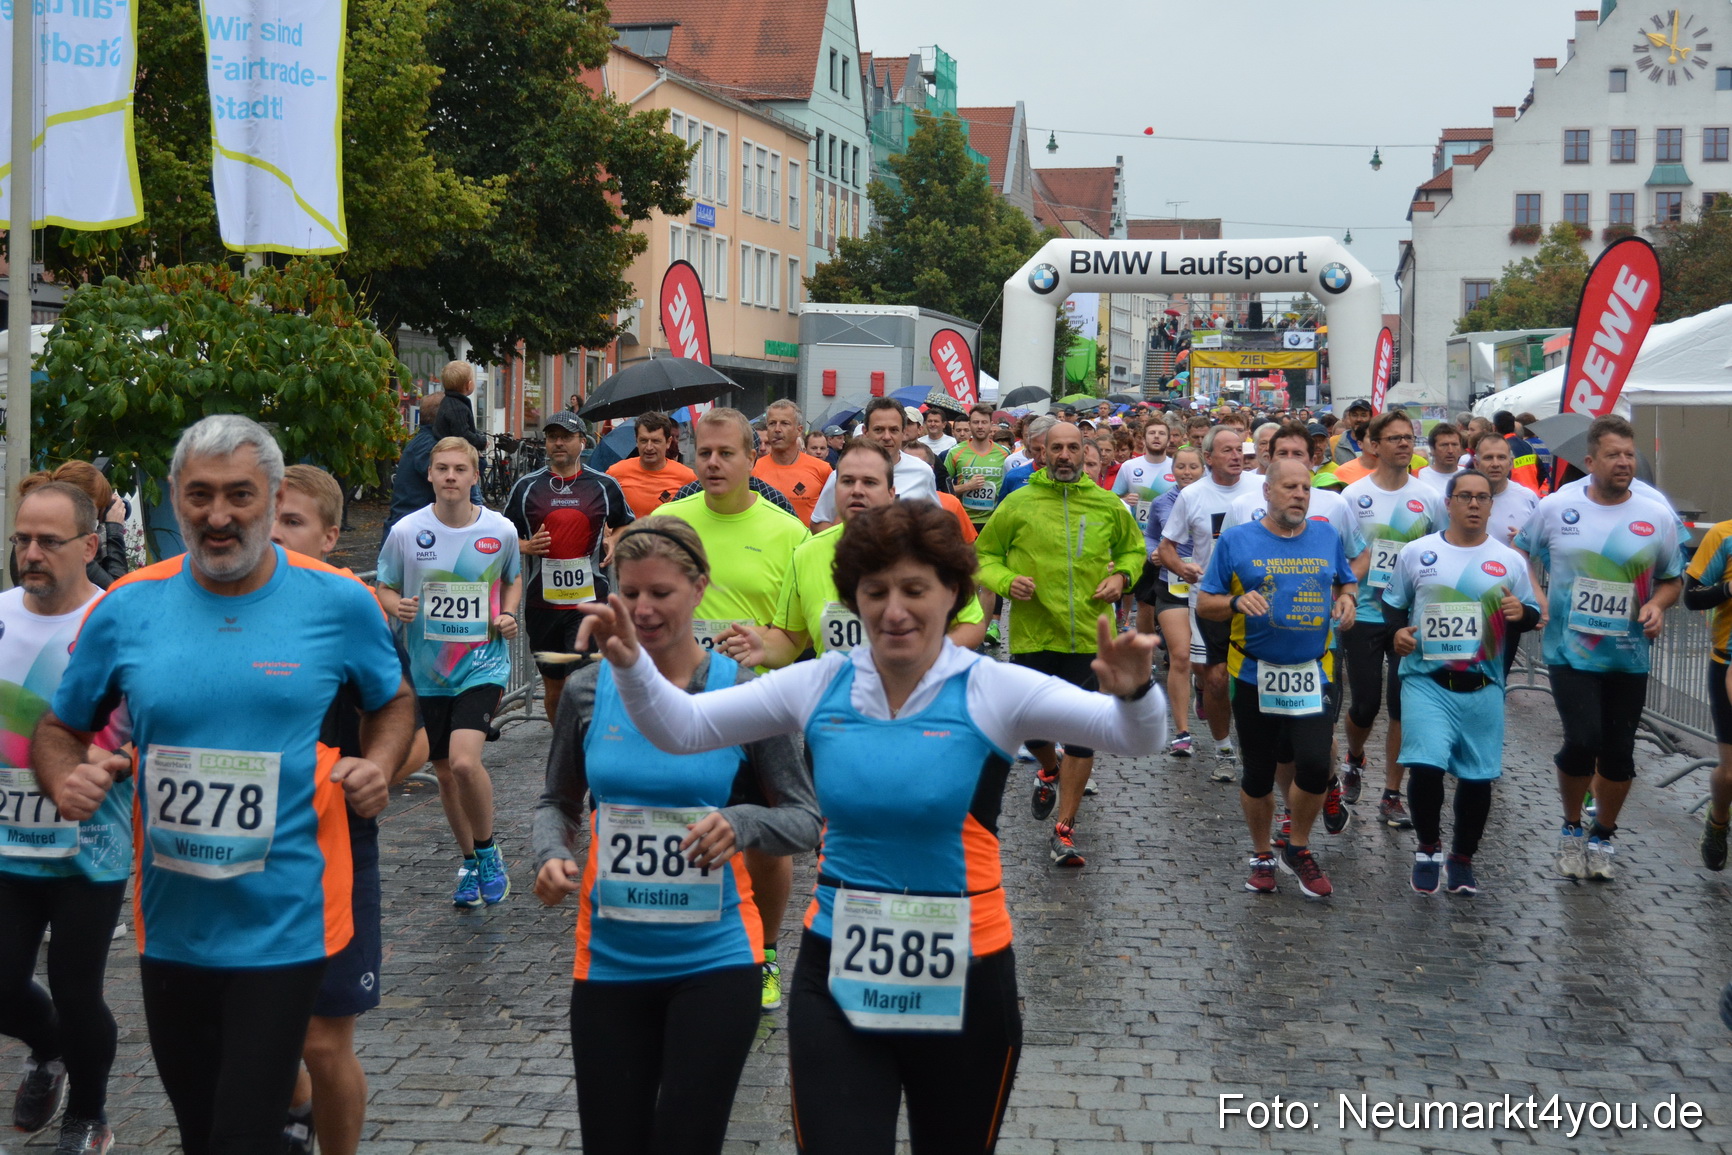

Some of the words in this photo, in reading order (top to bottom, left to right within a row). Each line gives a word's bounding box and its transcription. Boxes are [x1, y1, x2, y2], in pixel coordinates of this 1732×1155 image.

[206, 16, 252, 41] Wir
[260, 20, 303, 47] sind
[1070, 250, 1152, 275] BMW
[1161, 250, 1307, 279] Laufsport
[1570, 265, 1648, 417] REWE
[1241, 355, 1268, 365] ZIEL
[1373, 338, 1390, 413] REWE
[962, 467, 1001, 477] BOCK
[478, 541, 499, 551] Hervis
[1252, 559, 1265, 567] 10.
[1266, 558, 1328, 567] NEUMARKTER
[1376, 551, 1398, 570] 24
[1484, 563, 1504, 573] Hervis
[553, 569, 584, 587] 609
[1265, 566, 1320, 574] STADTLAUF
[431, 596, 480, 619] 2291
[1577, 591, 1627, 615] 2044
[442, 624, 468, 634] Tobias
[1426, 617, 1477, 638] 2524
[1588, 617, 1612, 628] Oskar
[828, 620, 861, 647] 30
[1441, 643, 1462, 652] Marc
[1265, 671, 1314, 692] 2038
[1275, 697, 1304, 707] Norbert
[154, 760, 192, 770] NeuerMarkt
[200, 753, 266, 772] BOCK
[157, 777, 263, 830] 2278
[608, 817, 645, 825] NeuerMarkt
[8, 829, 56, 845] Manfred
[176, 838, 233, 861] Werner
[627, 888, 689, 906] Kristina
[844, 906, 882, 916] NeuerMarkt
[890, 900, 957, 919] BOCK
[843, 924, 955, 979] 2585
[863, 988, 922, 1013] Margit
